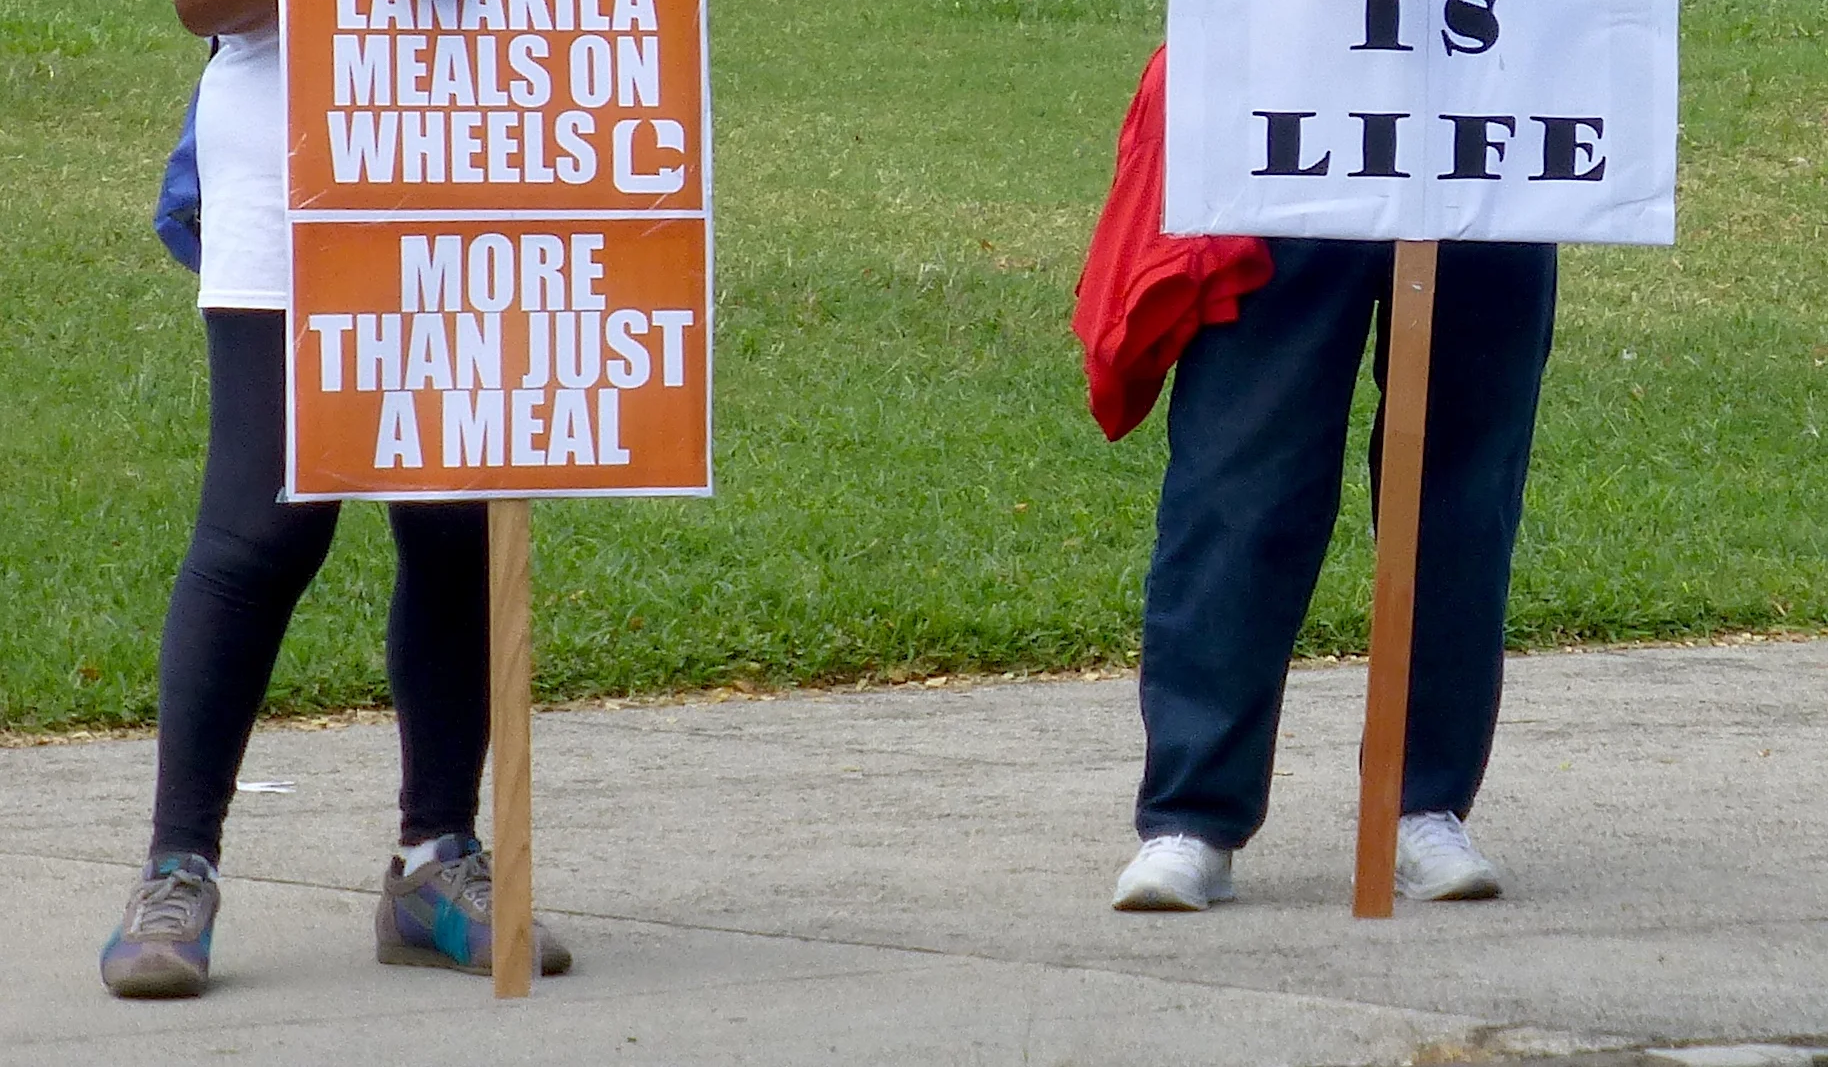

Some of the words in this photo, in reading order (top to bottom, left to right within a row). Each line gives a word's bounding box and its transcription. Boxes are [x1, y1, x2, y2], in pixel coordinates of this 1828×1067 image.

[332, 34, 552, 107] MEALS
[569, 34, 659, 108] ON
[326, 111, 597, 185] WHEELS
[1250, 111, 1607, 182] LIFE
[401, 233, 606, 312] MORE
[309, 313, 500, 392] THAN
[522, 309, 694, 390] JUST
[374, 390, 423, 469] A
[442, 388, 631, 468] MEAL
